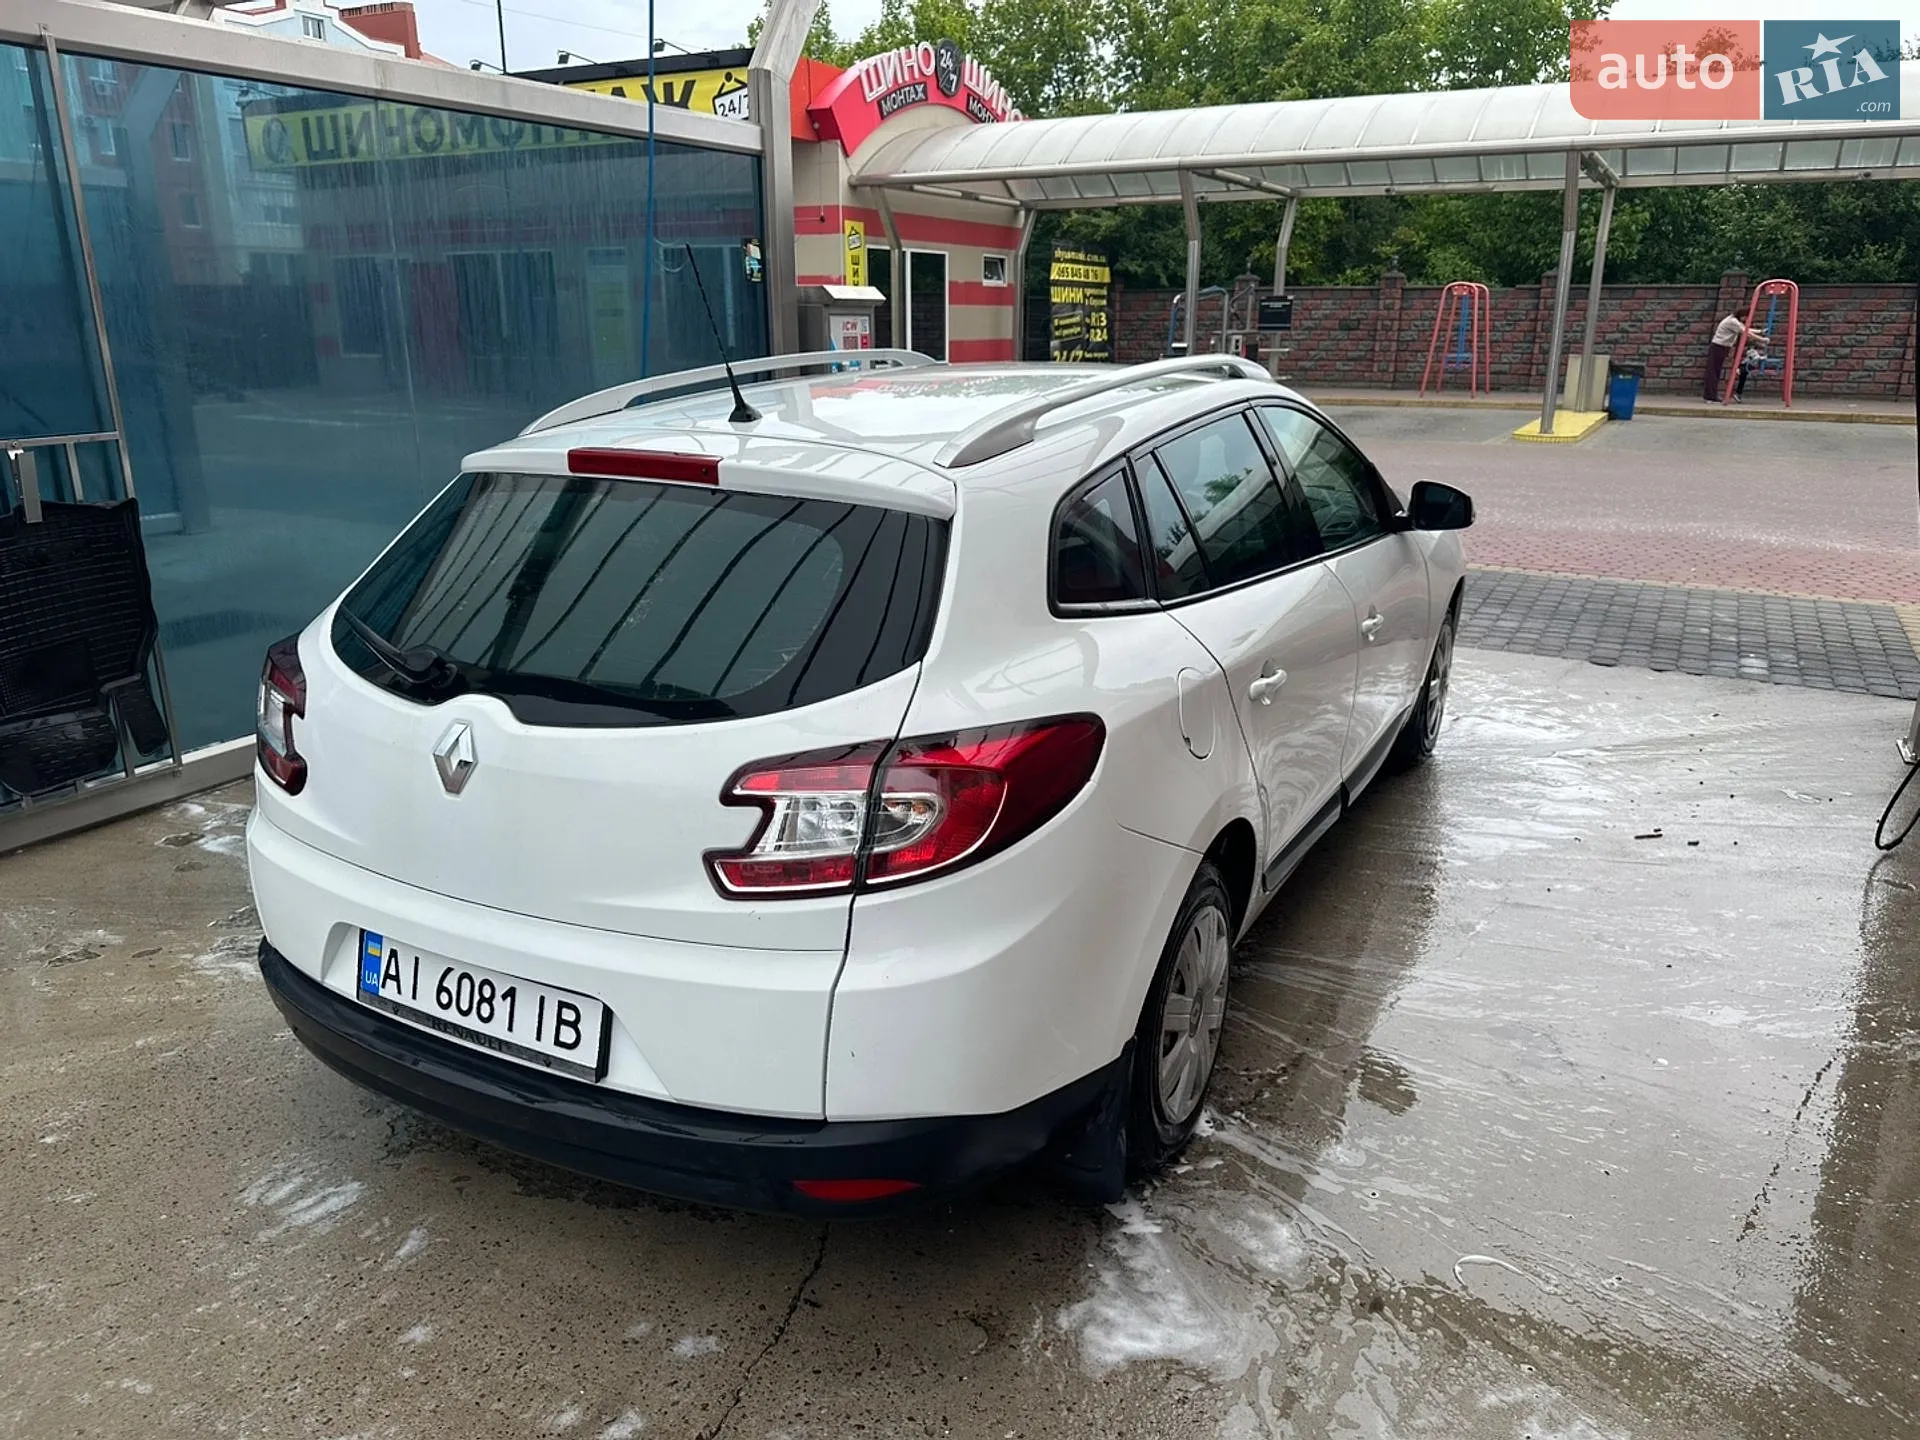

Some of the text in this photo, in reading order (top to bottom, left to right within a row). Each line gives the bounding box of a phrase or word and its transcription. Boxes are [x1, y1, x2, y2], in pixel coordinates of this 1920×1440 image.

[860, 41, 936, 103] ШИНО
[938, 49, 958, 93] 24/7
[881, 84, 997, 123] МОНТАЖ МОНТ
[1050, 286, 1084, 304] ШИНИ
[365, 970, 378, 988] UA
[381, 948, 582, 1050] AI 6081 IB
